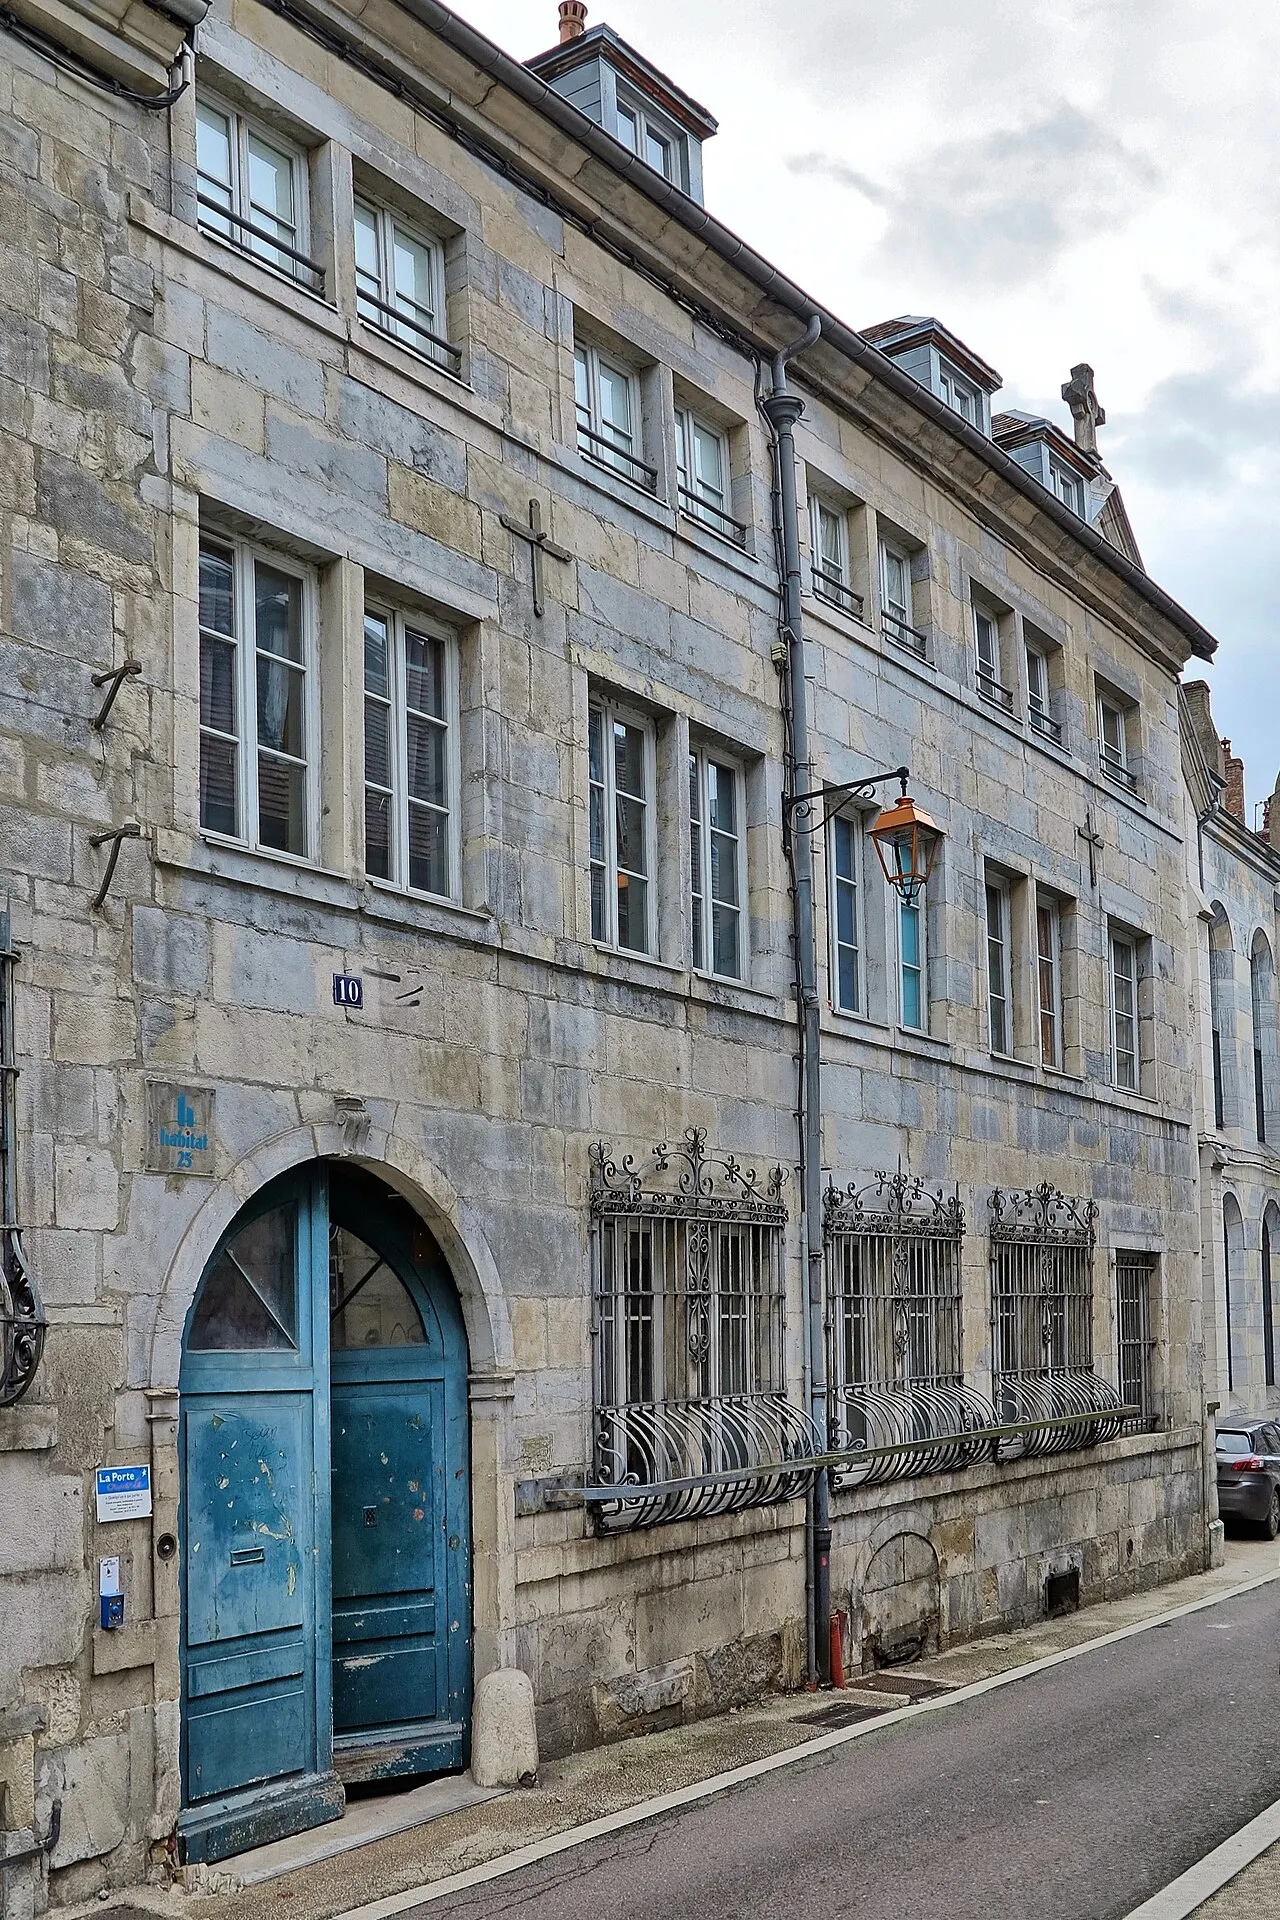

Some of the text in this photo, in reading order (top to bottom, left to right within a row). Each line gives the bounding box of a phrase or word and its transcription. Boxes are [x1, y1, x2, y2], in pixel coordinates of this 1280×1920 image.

[339, 979, 359, 1002] 10
[160, 1127, 209, 1151] habitat
[176, 1151, 193, 1168] 25
[98, 1472, 135, 1483] La Porte
